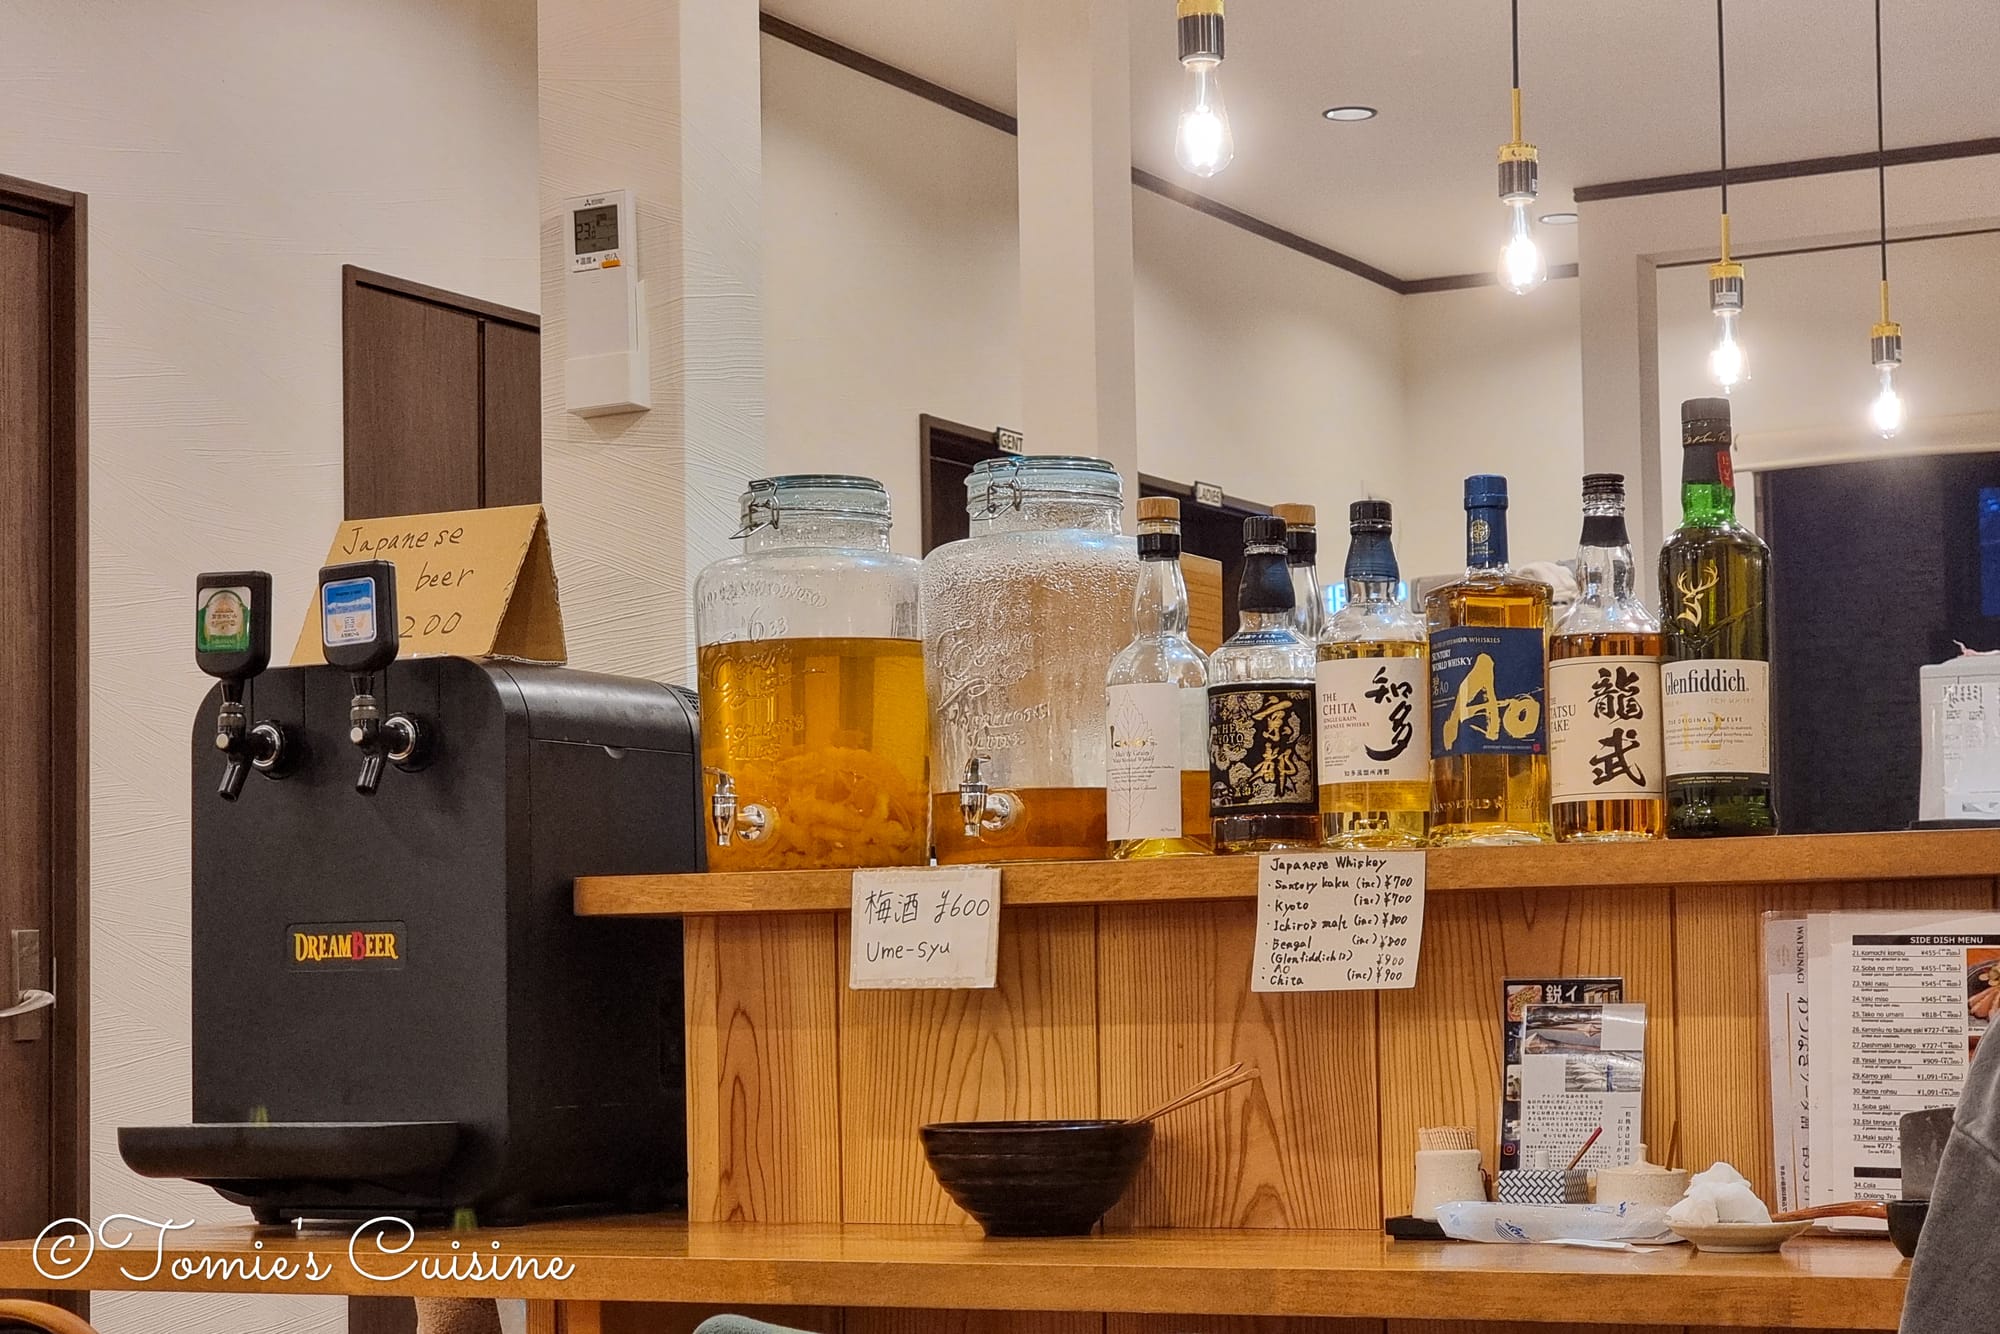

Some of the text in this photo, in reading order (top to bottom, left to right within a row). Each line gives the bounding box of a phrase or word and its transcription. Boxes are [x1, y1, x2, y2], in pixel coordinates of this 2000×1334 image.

[342, 527, 464, 559] Japanese
[415, 561, 474, 592] beer
[1447, 657, 1473, 669] WHISKY
[1665, 668, 1746, 695] Glenfiddich
[1322, 692, 1337, 702] THE
[1443, 652, 1541, 751] Ao
[1322, 702, 1357, 716] CHITA
[1364, 666, 1413, 761] 知多
[1588, 666, 1646, 787] 龍武
[1678, 717, 1711, 725] ORIGINAL
[1270, 855, 1387, 875] Japanese Whiskey
[1384, 874, 1413, 889] ¥700
[864, 889, 990, 924] 梅酒 ¥600
[1275, 899, 1309, 917] Kyoto
[1384, 891, 1412, 907] ¥700
[1909, 936, 1984, 944] SIDE DISH MENU
[1270, 973, 1304, 986] Chita
